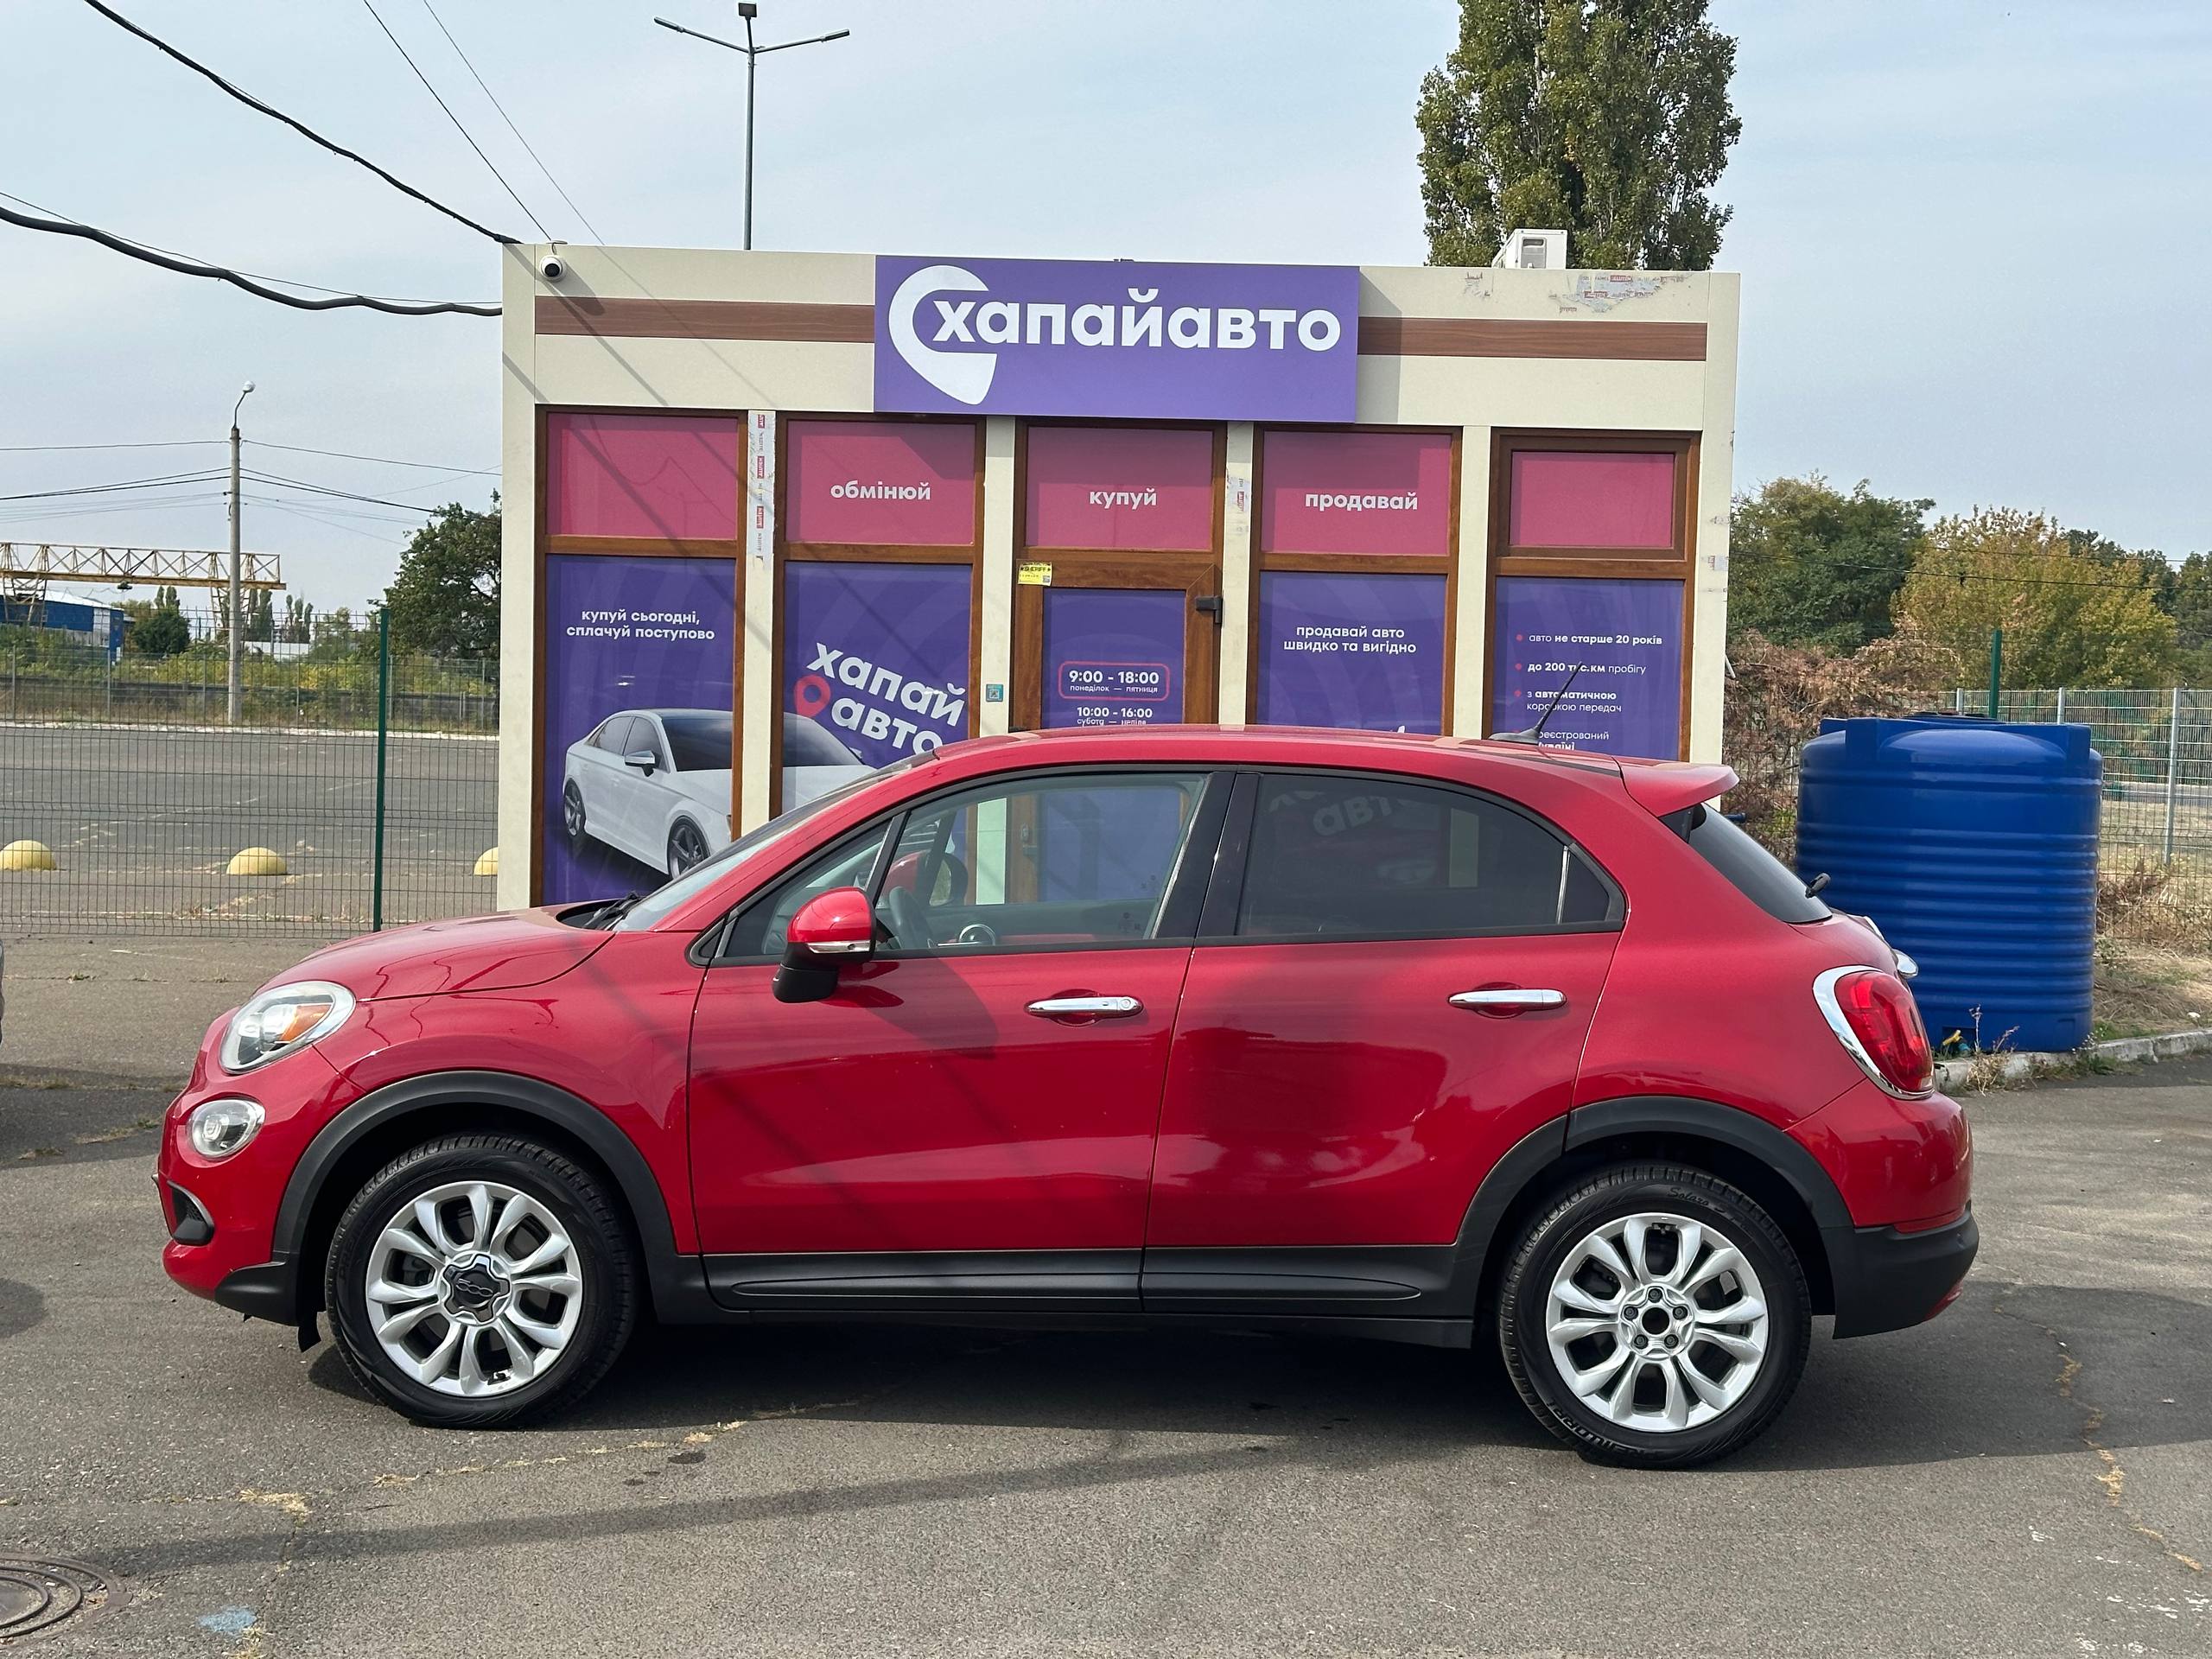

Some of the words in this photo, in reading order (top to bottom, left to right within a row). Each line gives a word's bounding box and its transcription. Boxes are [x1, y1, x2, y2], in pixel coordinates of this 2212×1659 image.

[932, 288, 1341, 351] хапайавто
[830, 480, 931, 500] обмінюй
[1090, 487, 1157, 510] купуй
[1305, 492, 1418, 512] продавай
[582, 608, 626, 623] купуй
[631, 611, 700, 625] сьогодні,
[566, 625, 631, 639] сплачуй
[635, 627, 715, 642] поступово
[1296, 626, 1367, 639] продавай
[1371, 628, 1405, 639] авто
[1529, 634, 1552, 643] авто
[1554, 635, 1568, 644] не
[1571, 635, 1613, 645] старше
[1616, 635, 1630, 644] 20
[1632, 635, 1662, 646] років
[1283, 640, 1338, 653] швидко
[1342, 642, 1358, 652] та
[1363, 641, 1417, 654] вигідно
[1528, 663, 1542, 673] до
[1545, 662, 1566, 671] 200
[1568, 664, 1605, 673] тс.км
[1608, 664, 1646, 676] пробігу
[806, 642, 966, 727] хапай
[1069, 670, 1103, 683] 9:00
[1118, 671, 1159, 684] 18:00
[1077, 707, 1109, 717] 10:00
[1121, 708, 1153, 718] 16:00
[1527, 703, 1577, 713] корокою
[1579, 704, 1622, 714] передач
[831, 697, 944, 755] авто
[1077, 717, 1104, 727] субота
